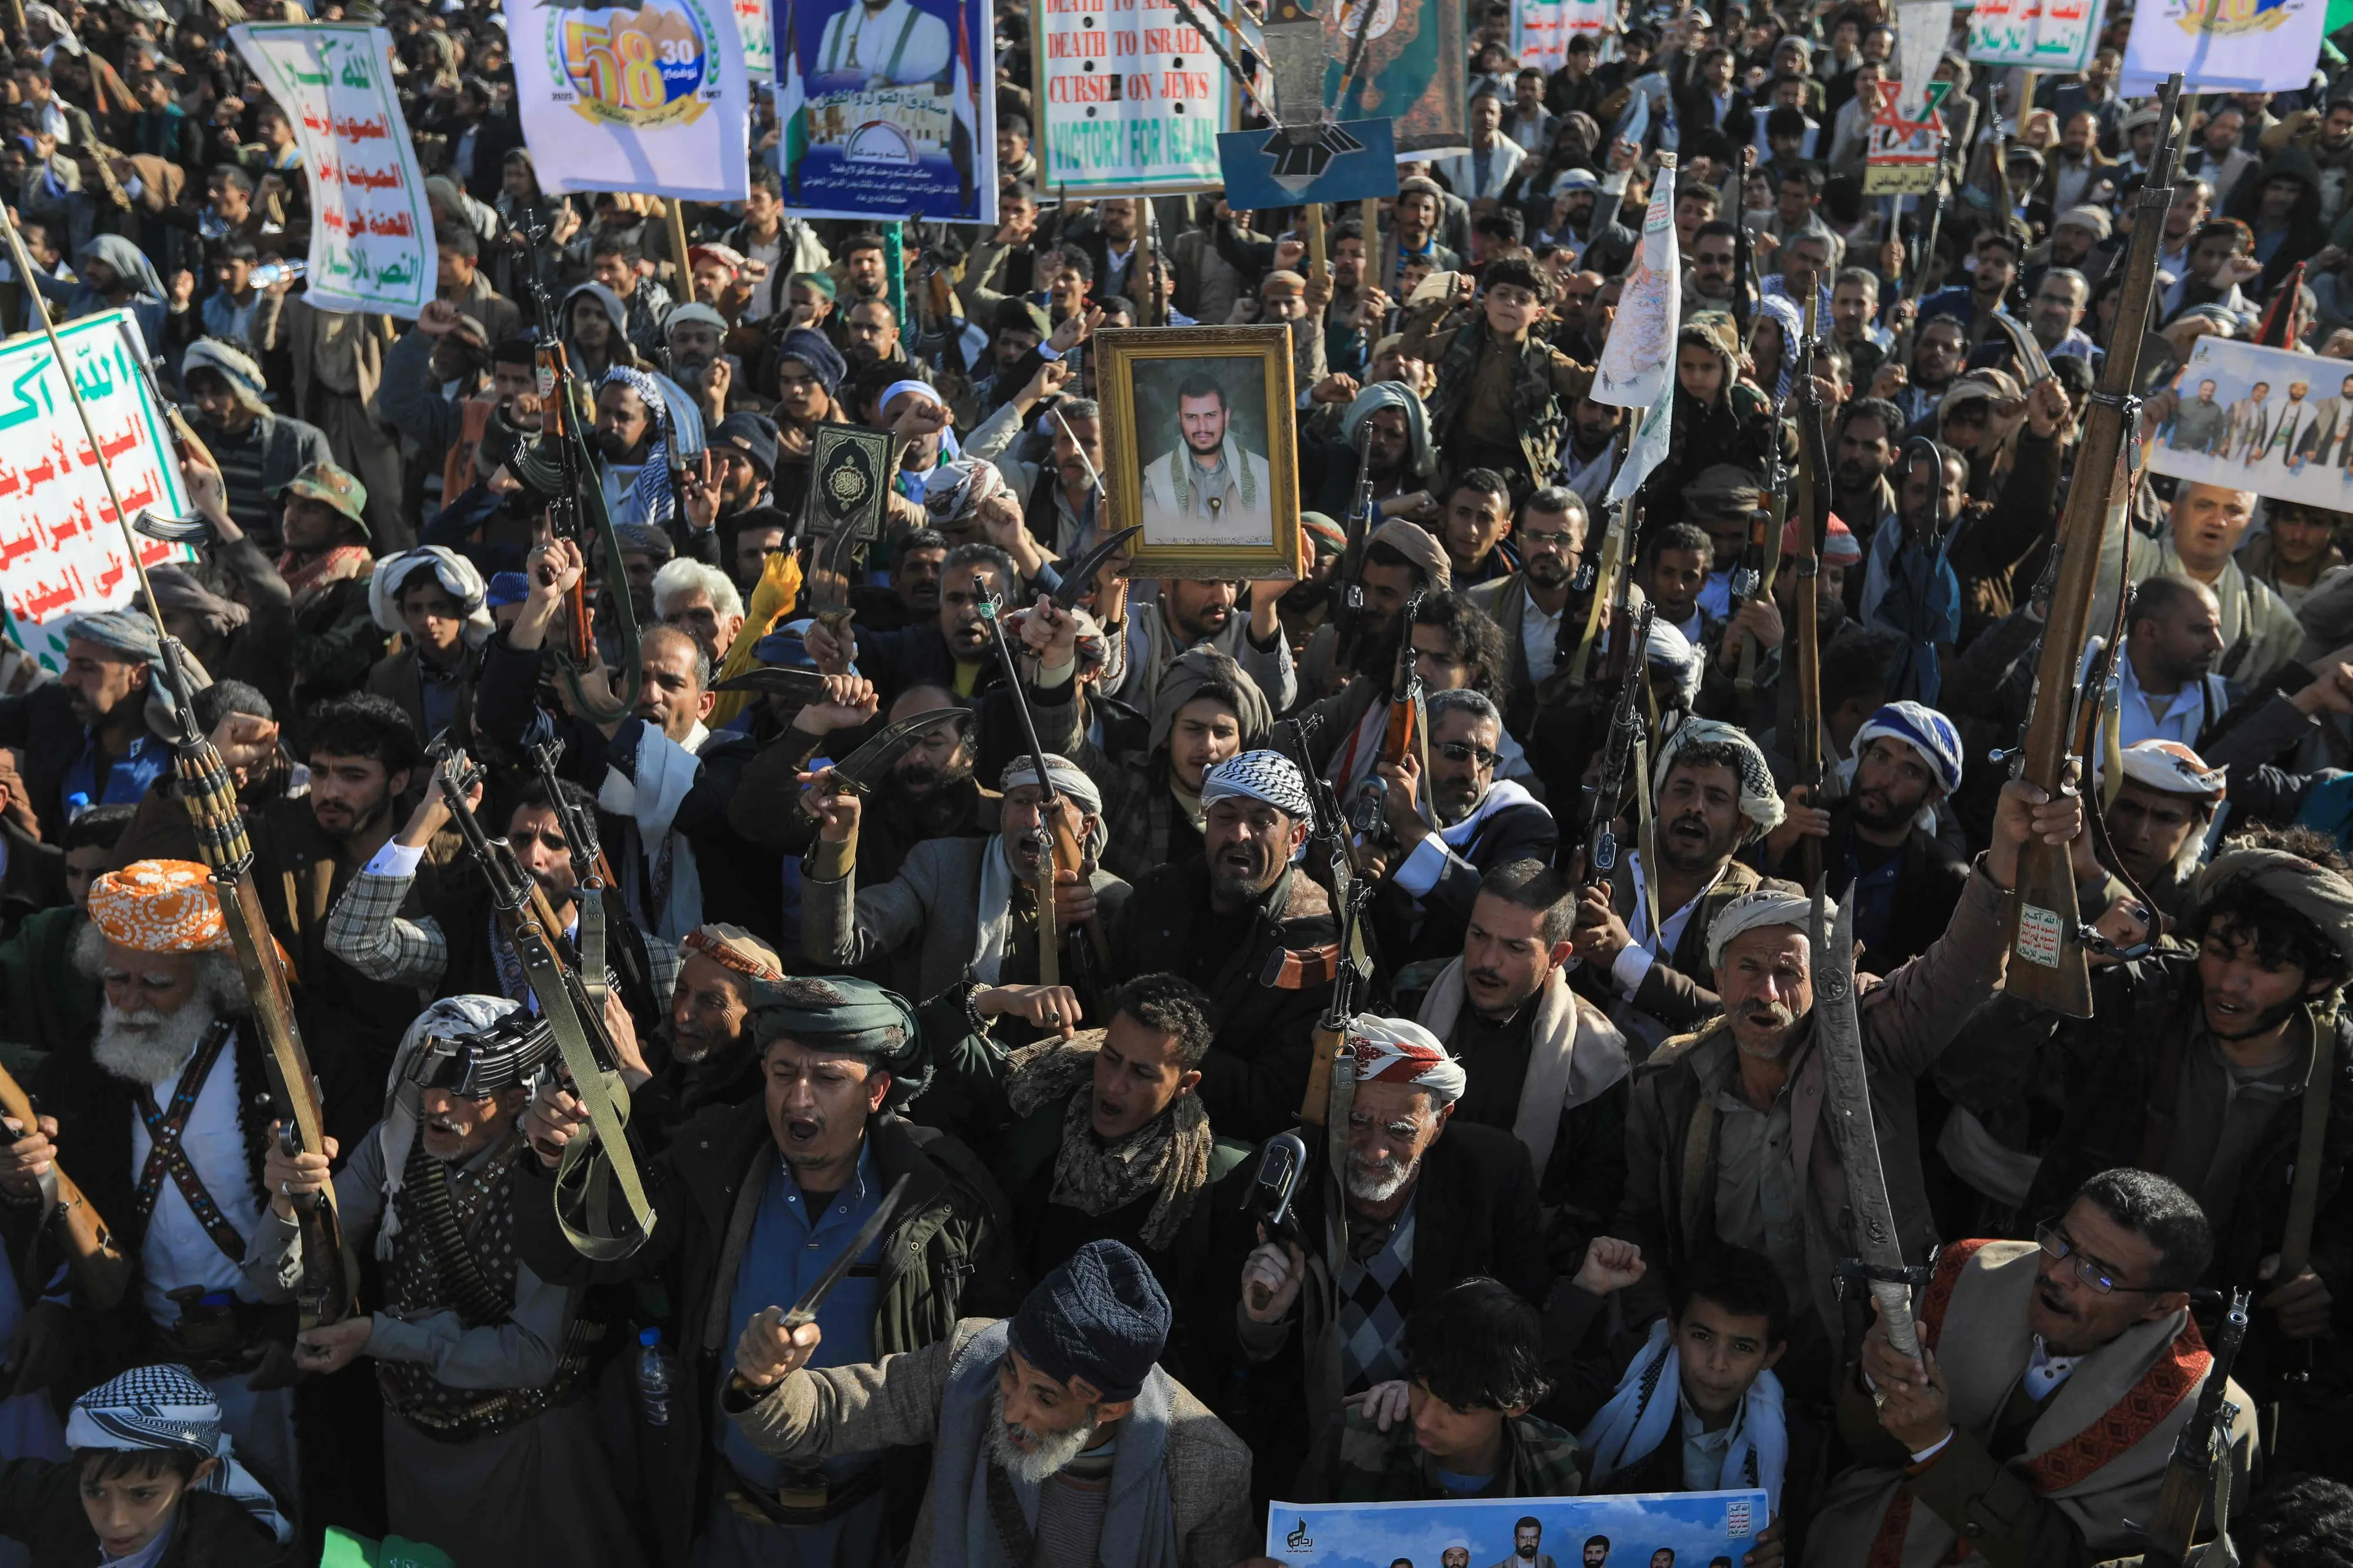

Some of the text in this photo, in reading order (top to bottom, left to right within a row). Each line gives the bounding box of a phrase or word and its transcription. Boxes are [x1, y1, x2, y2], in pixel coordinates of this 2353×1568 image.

[660, 38, 695, 65] 30
[1048, 28, 1205, 58] DEATH TO ISRAEL
[563, 21, 665, 112] 58
[906, 94, 949, 115] صادق
[1049, 72, 1209, 103] CURSE ON JEWS
[1052, 118, 1217, 171] VICTORY FOR ISLAM
[373, 252, 419, 292] النصر
[69, 341, 128, 403] الله
[93, 549, 124, 599] على
[12, 563, 86, 627] اليهود
[2039, 935, 2056, 943] الموت
